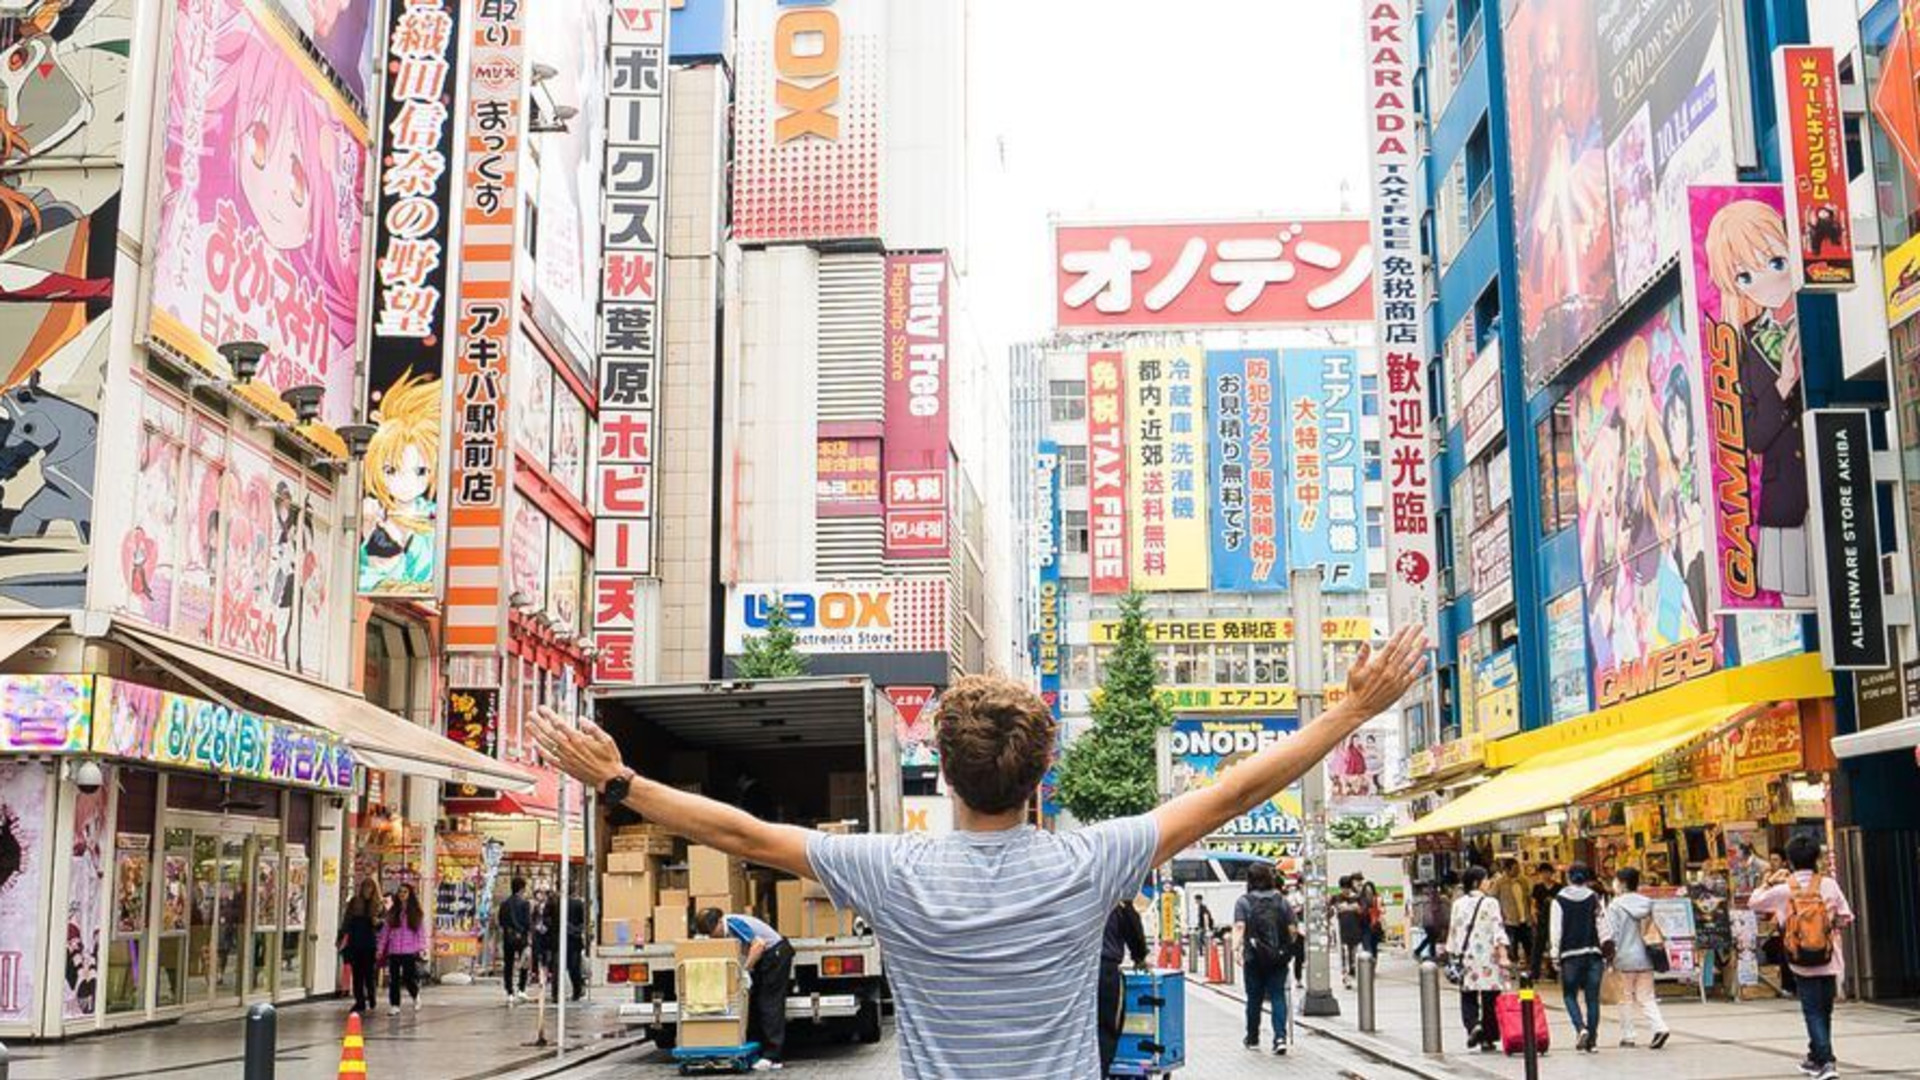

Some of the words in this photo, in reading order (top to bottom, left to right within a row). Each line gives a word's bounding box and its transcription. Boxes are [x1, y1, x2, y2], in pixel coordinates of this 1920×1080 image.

[375, 0, 452, 336] 織田信奈の野望
[474, 99, 511, 214] まっくす
[1061, 223, 1374, 313] オノデン
[1383, 255, 1417, 344] 免税商店
[461, 305, 500, 504] アキバ駅前店
[1385, 352, 1430, 535] 歓迎光臨
[1705, 311, 1759, 599] GAMERS
[1836, 428, 1849, 480] AKIBA
[1094, 496, 1124, 579] FREE
[1839, 485, 1857, 542] STORE
[1156, 622, 1216, 640] FREE
[1222, 621, 1276, 640] 免税店
[1844, 545, 1865, 650] ALIENWARE
[1219, 689, 1286, 706] エアコン
[1600, 628, 1718, 709] GAMERS
